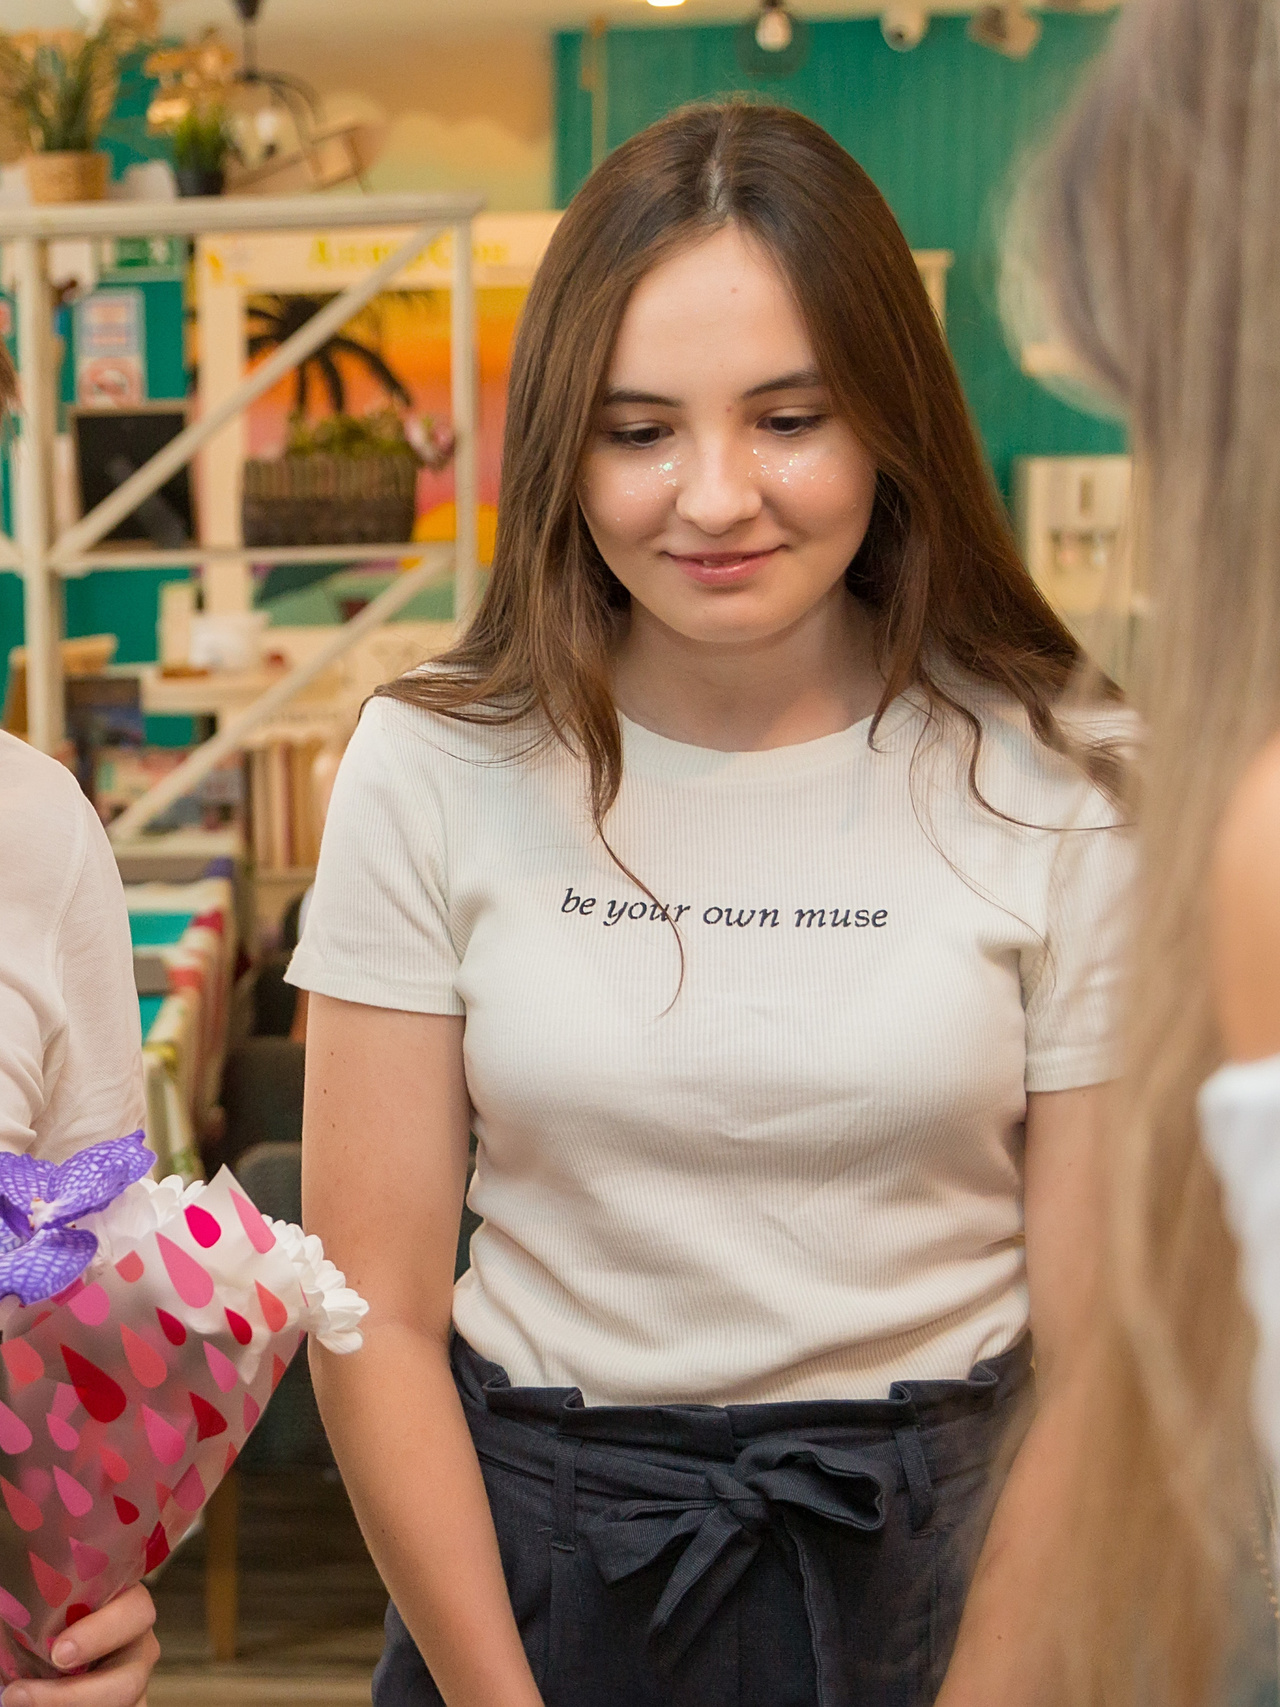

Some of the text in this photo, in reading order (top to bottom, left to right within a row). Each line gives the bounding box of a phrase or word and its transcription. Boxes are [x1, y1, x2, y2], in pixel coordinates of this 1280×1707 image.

[561, 887, 889, 929] be your own muse
